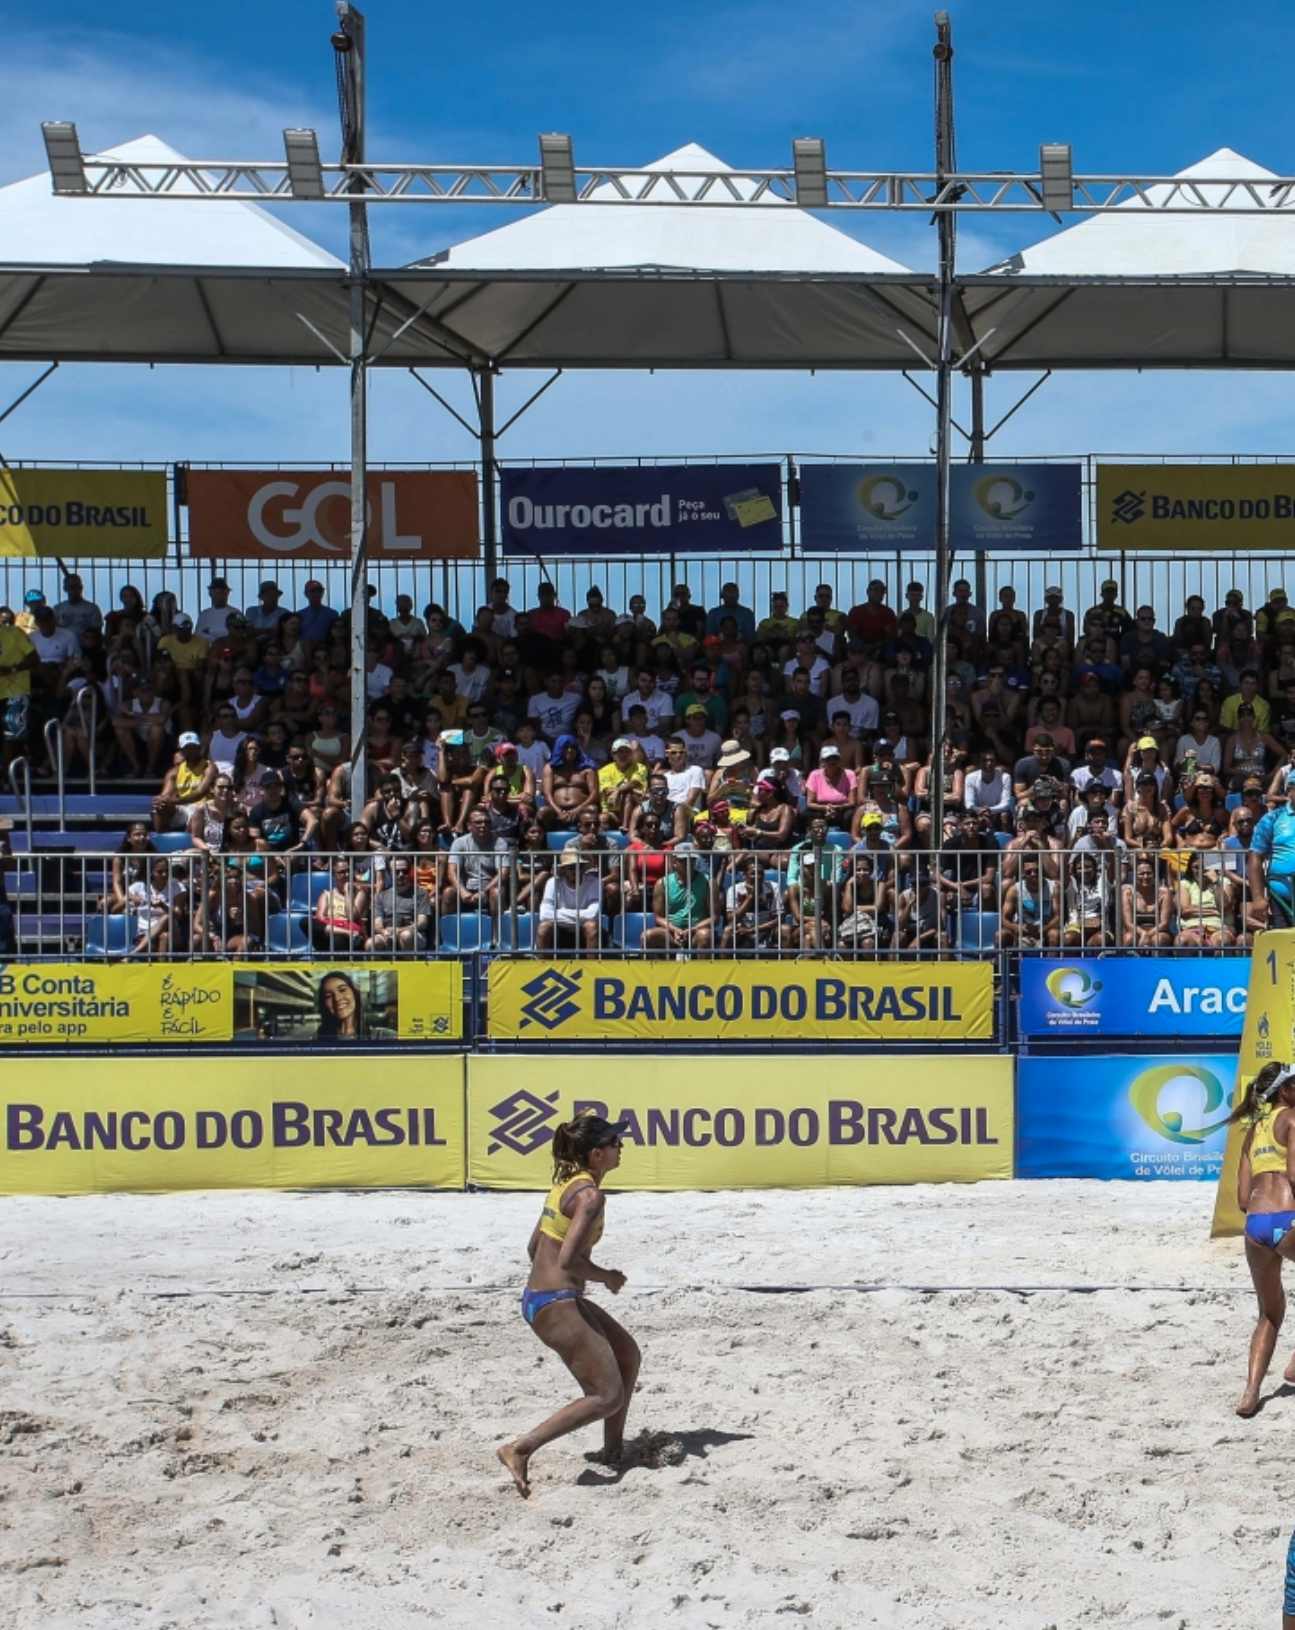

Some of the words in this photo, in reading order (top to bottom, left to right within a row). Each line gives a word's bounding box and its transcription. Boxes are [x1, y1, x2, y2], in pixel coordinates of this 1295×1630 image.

[28, 505, 61, 526] DO
[66, 501, 152, 528] BRASIL
[248, 480, 422, 551] GOL
[508, 494, 672, 529] Ourocard
[678, 499, 705, 511] Peça
[691, 512, 698, 520] o
[700, 512, 720, 520] seu
[1152, 495, 1235, 520] BANCO
[1239, 499, 1270, 520] DO
[1266, 949, 1277, 985] 1
[23, 974, 96, 995] Conta
[1147, 978, 1248, 1014] Arac
[593, 977, 743, 1021] BANCO
[750, 984, 807, 1020] DO
[815, 977, 962, 1022] BRASIL
[18, 1021, 52, 1036] pelo
[57, 1023, 87, 1036] app
[6, 1103, 186, 1151] BANCO
[196, 1109, 263, 1149] DO
[272, 1101, 447, 1147] BRASIL
[755, 1107, 820, 1147] DO
[828, 1100, 998, 1145] BRASIL
[1130, 1152, 1180, 1163] Circuito
[1135, 1165, 1150, 1175] de
[1189, 1165, 1204, 1175] de
